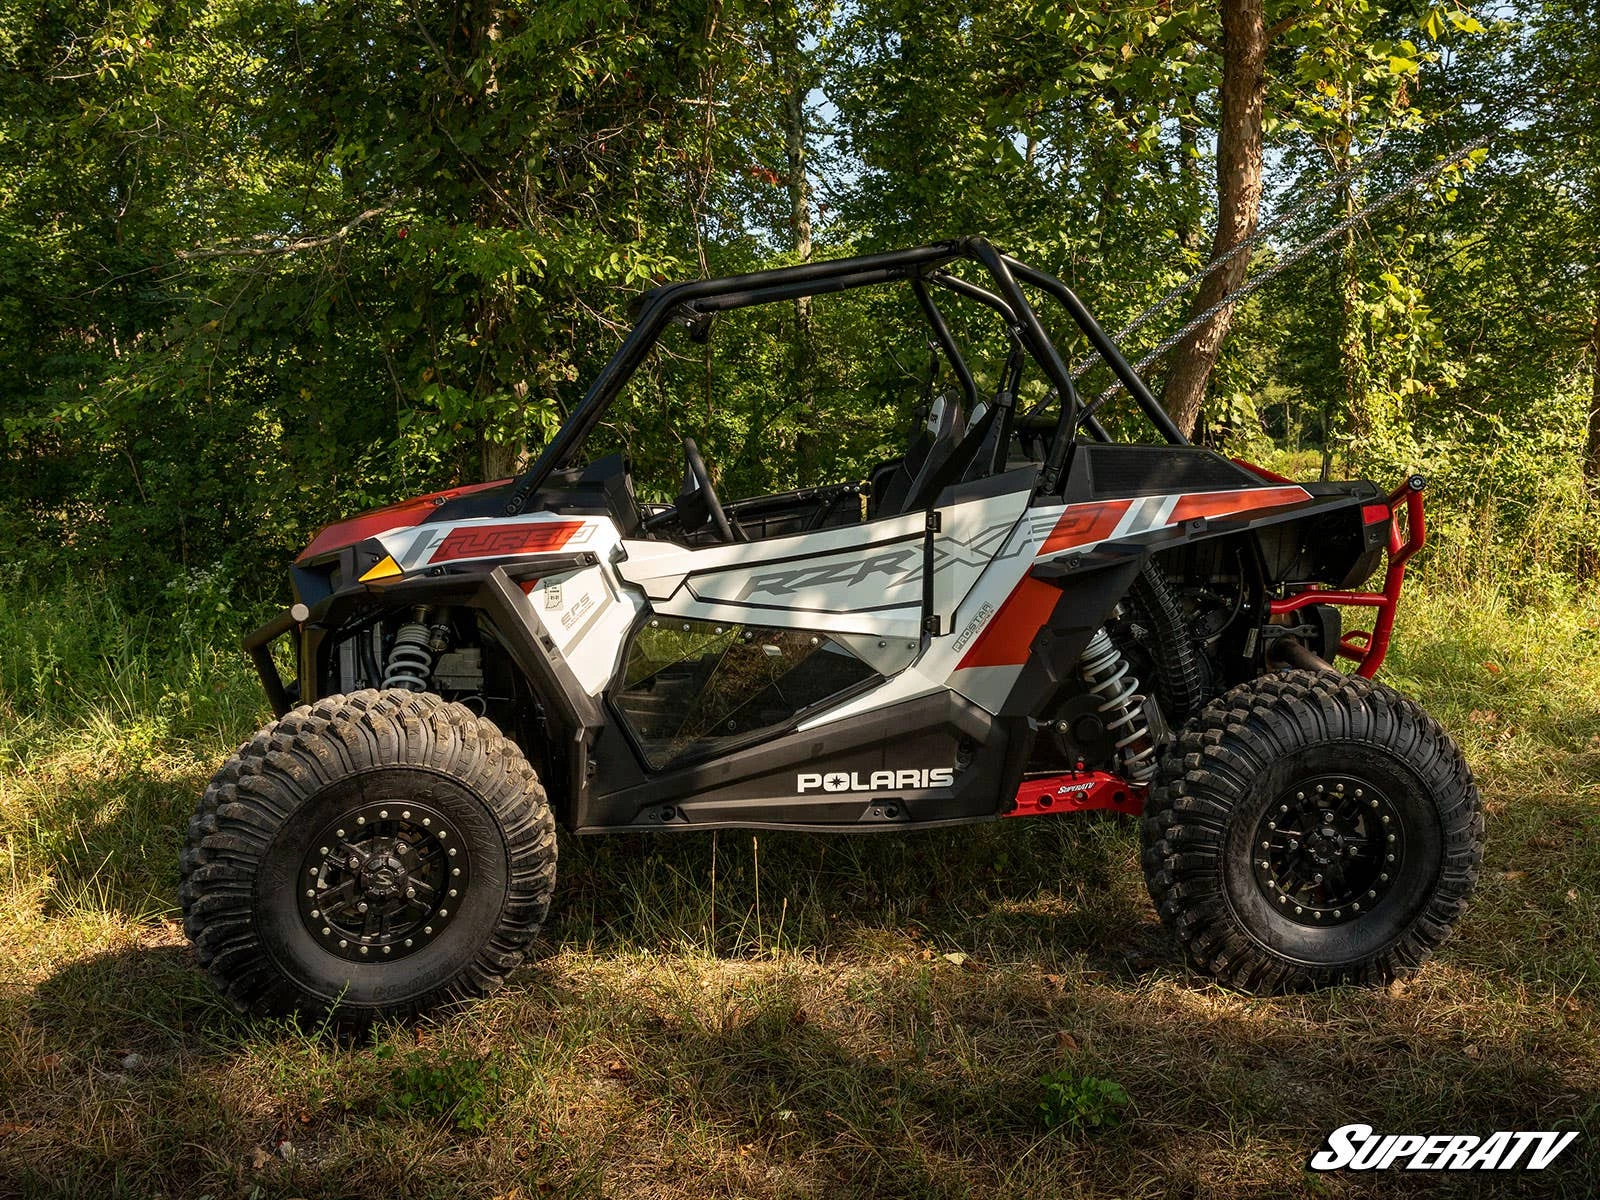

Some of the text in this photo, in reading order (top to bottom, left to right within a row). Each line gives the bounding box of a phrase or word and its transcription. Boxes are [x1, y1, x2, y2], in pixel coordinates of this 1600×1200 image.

[427, 524, 599, 557] TURBO
[734, 549, 917, 600] RZR
[561, 592, 590, 626] EPS
[797, 768, 954, 793] POLARIS
